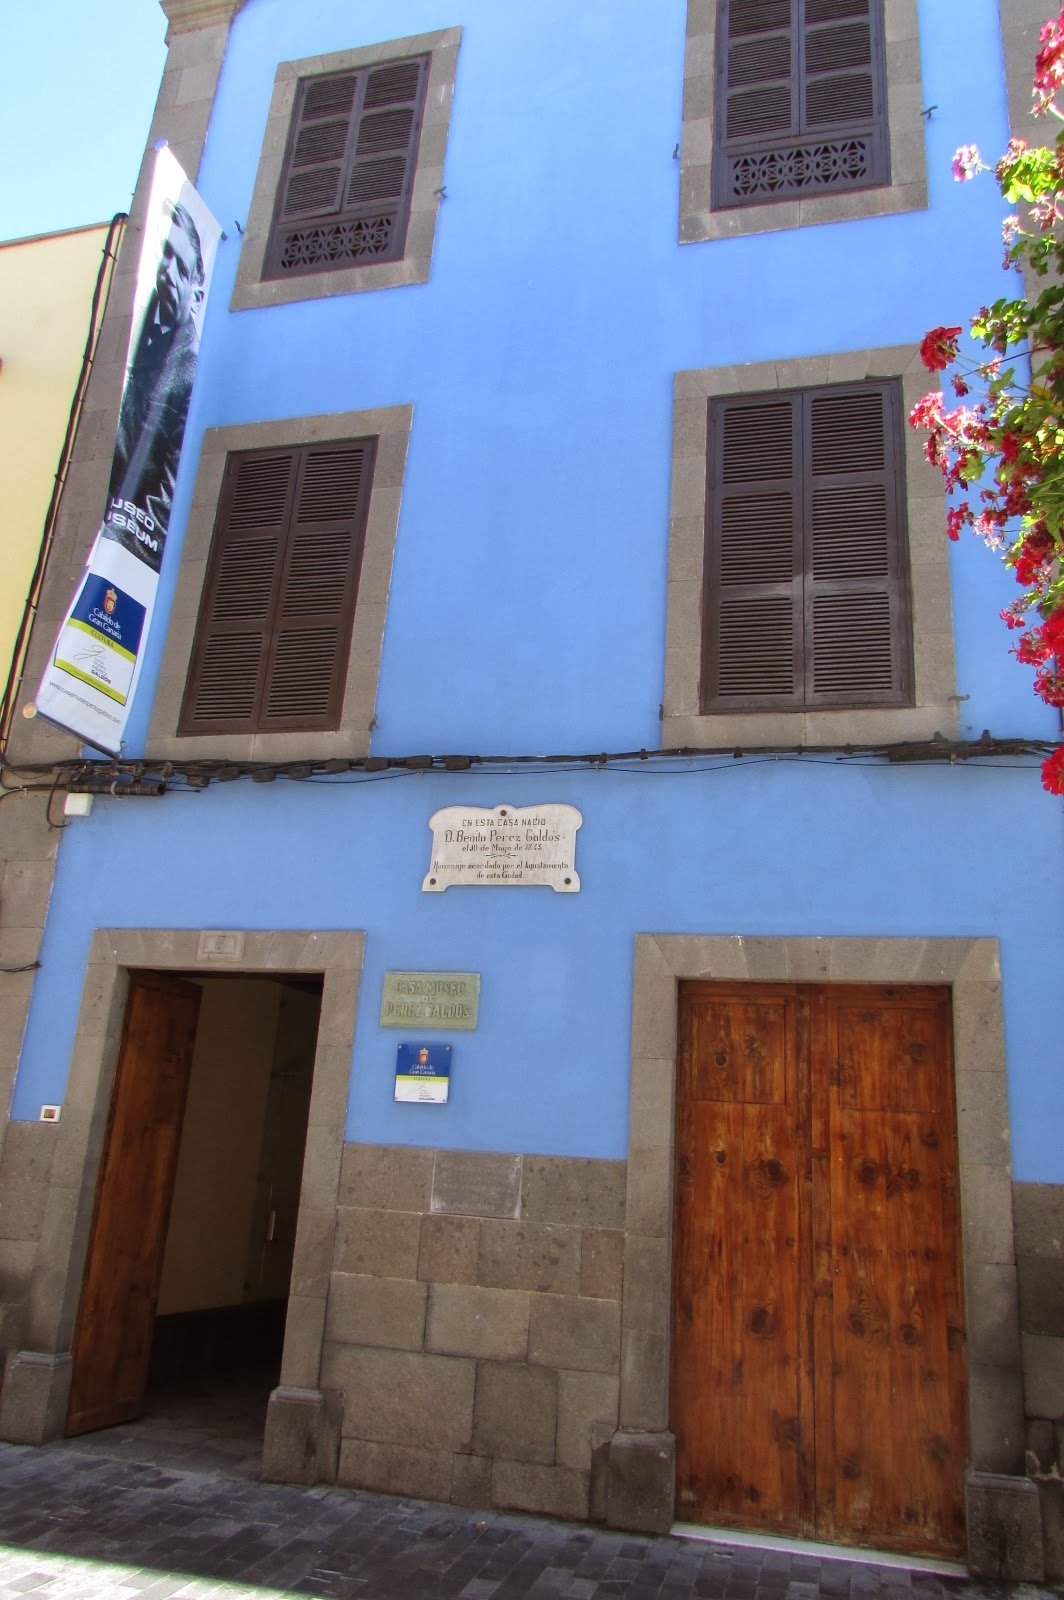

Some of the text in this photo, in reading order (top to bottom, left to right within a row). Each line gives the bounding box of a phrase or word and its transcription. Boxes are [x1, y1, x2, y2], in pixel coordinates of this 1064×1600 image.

[111, 497, 154, 531] USEO
[108, 511, 158, 552] SEUM
[88, 613, 122, 640] Gran Canaria
[93, 607, 121, 630] Cabildo de
[462, 819, 473, 827] EN
[475, 818, 495, 827] ESTA
[497, 818, 518, 827] CASA
[480, 844, 490, 852] de
[491, 843, 512, 853] Mayo
[514, 843, 523, 851] de
[502, 863, 515, 871] por
[516, 860, 523, 869] el
[476, 871, 485, 879] de
[385, 1001, 423, 1017] PEREZ
